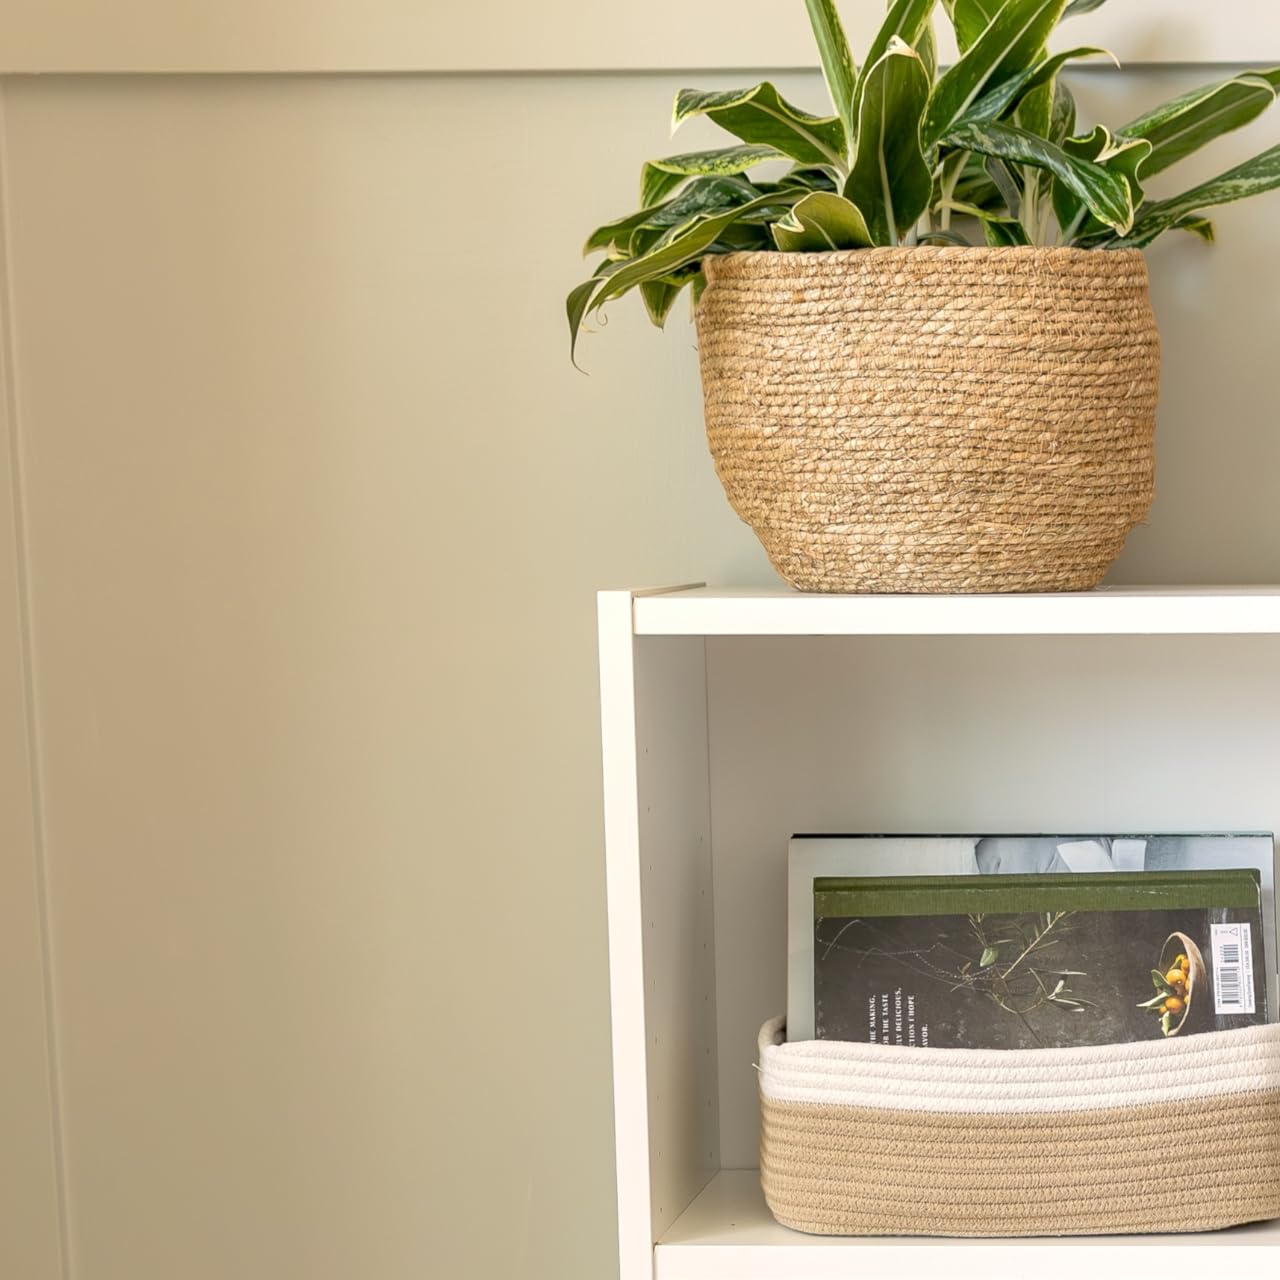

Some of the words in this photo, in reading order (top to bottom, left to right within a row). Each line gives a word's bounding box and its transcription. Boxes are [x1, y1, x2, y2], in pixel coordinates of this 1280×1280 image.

[868, 994, 877, 1027] MAKING,
[881, 994, 889, 1016] TASTE
[894, 987, 902, 1032] DELICIOUS,
[907, 995, 915, 1016] HOPE
